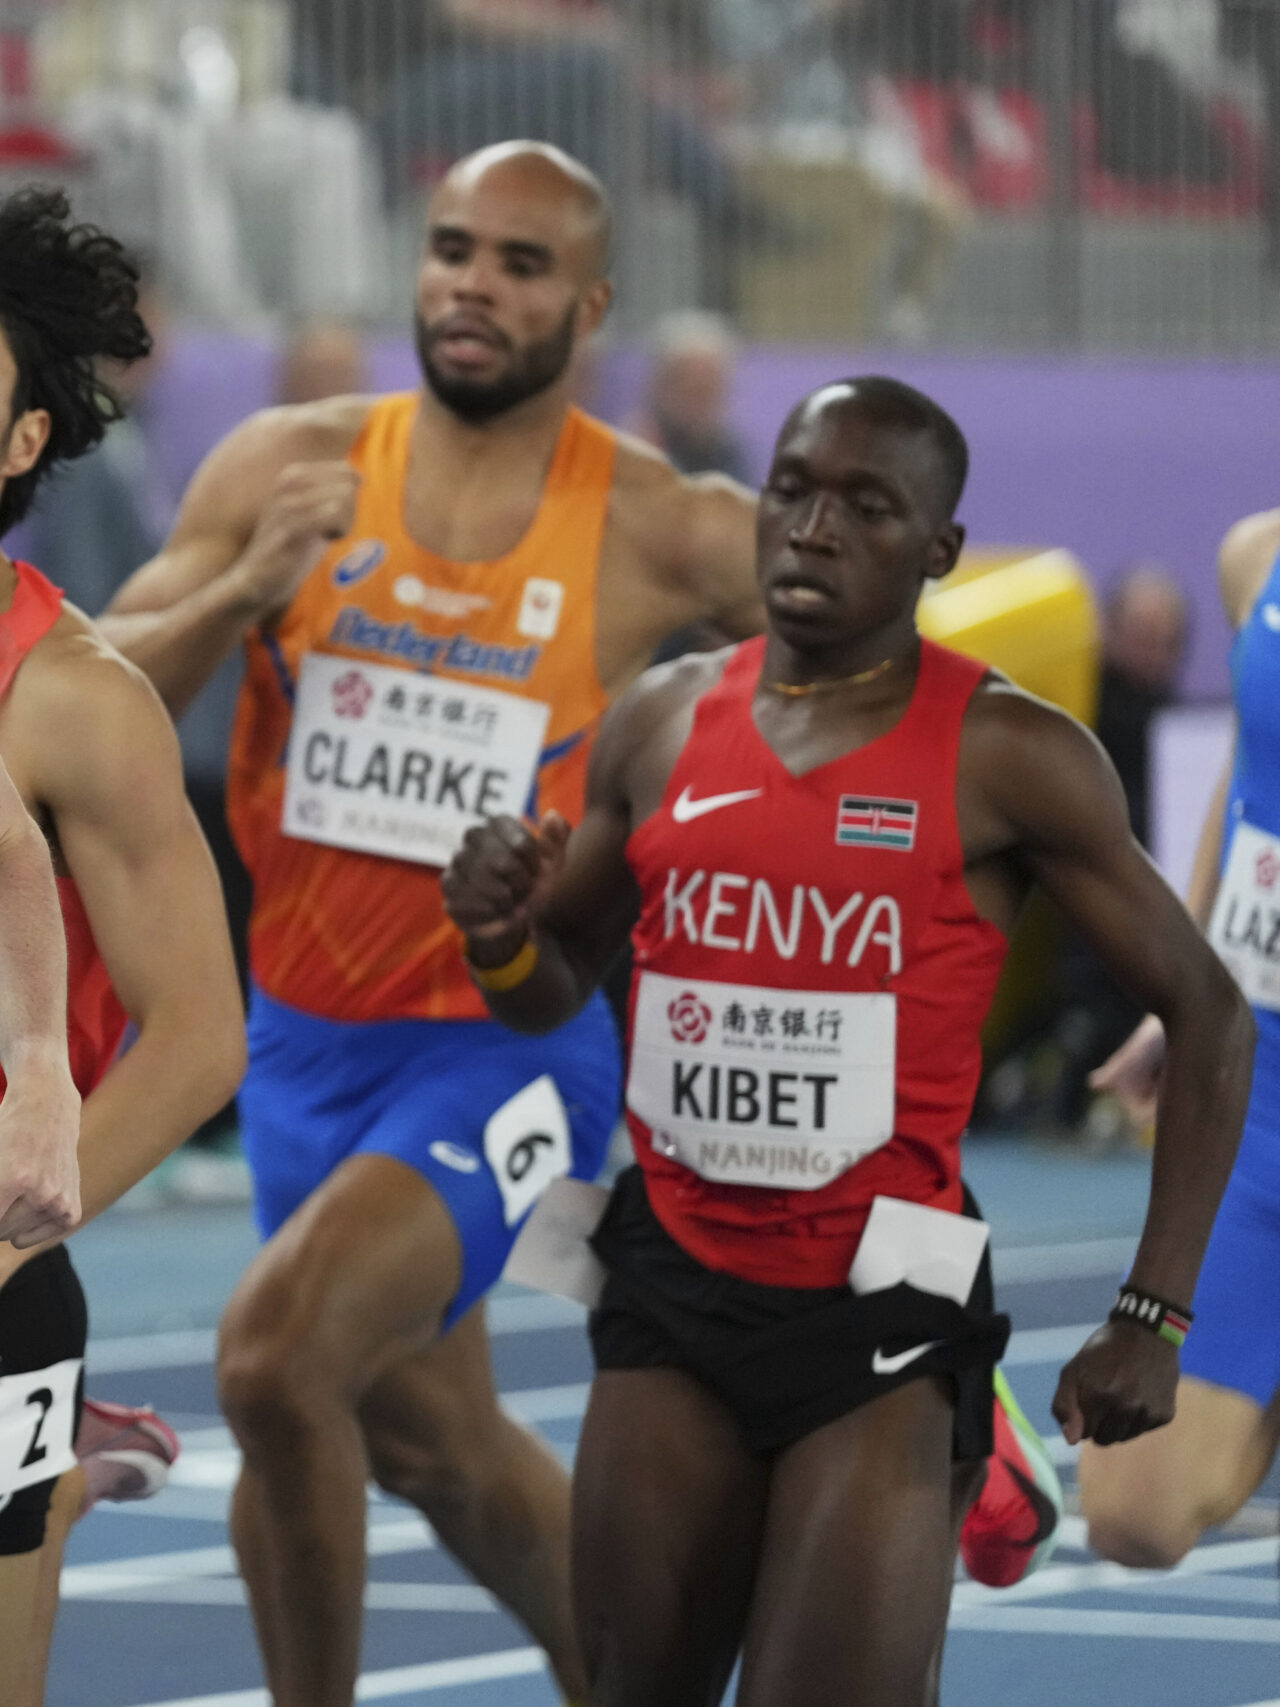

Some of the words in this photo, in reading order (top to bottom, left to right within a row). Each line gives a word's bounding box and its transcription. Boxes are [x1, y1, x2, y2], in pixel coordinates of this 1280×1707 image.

[303, 731, 508, 817] CLARKE
[665, 868, 901, 975] KENYA
[722, 1000, 843, 1041] 南京银行
[673, 1061, 838, 1129] KIBET
[507, 1131, 554, 1183] 6
[700, 1142, 830, 1176] NANJING
[20, 1388, 53, 1470] 2
